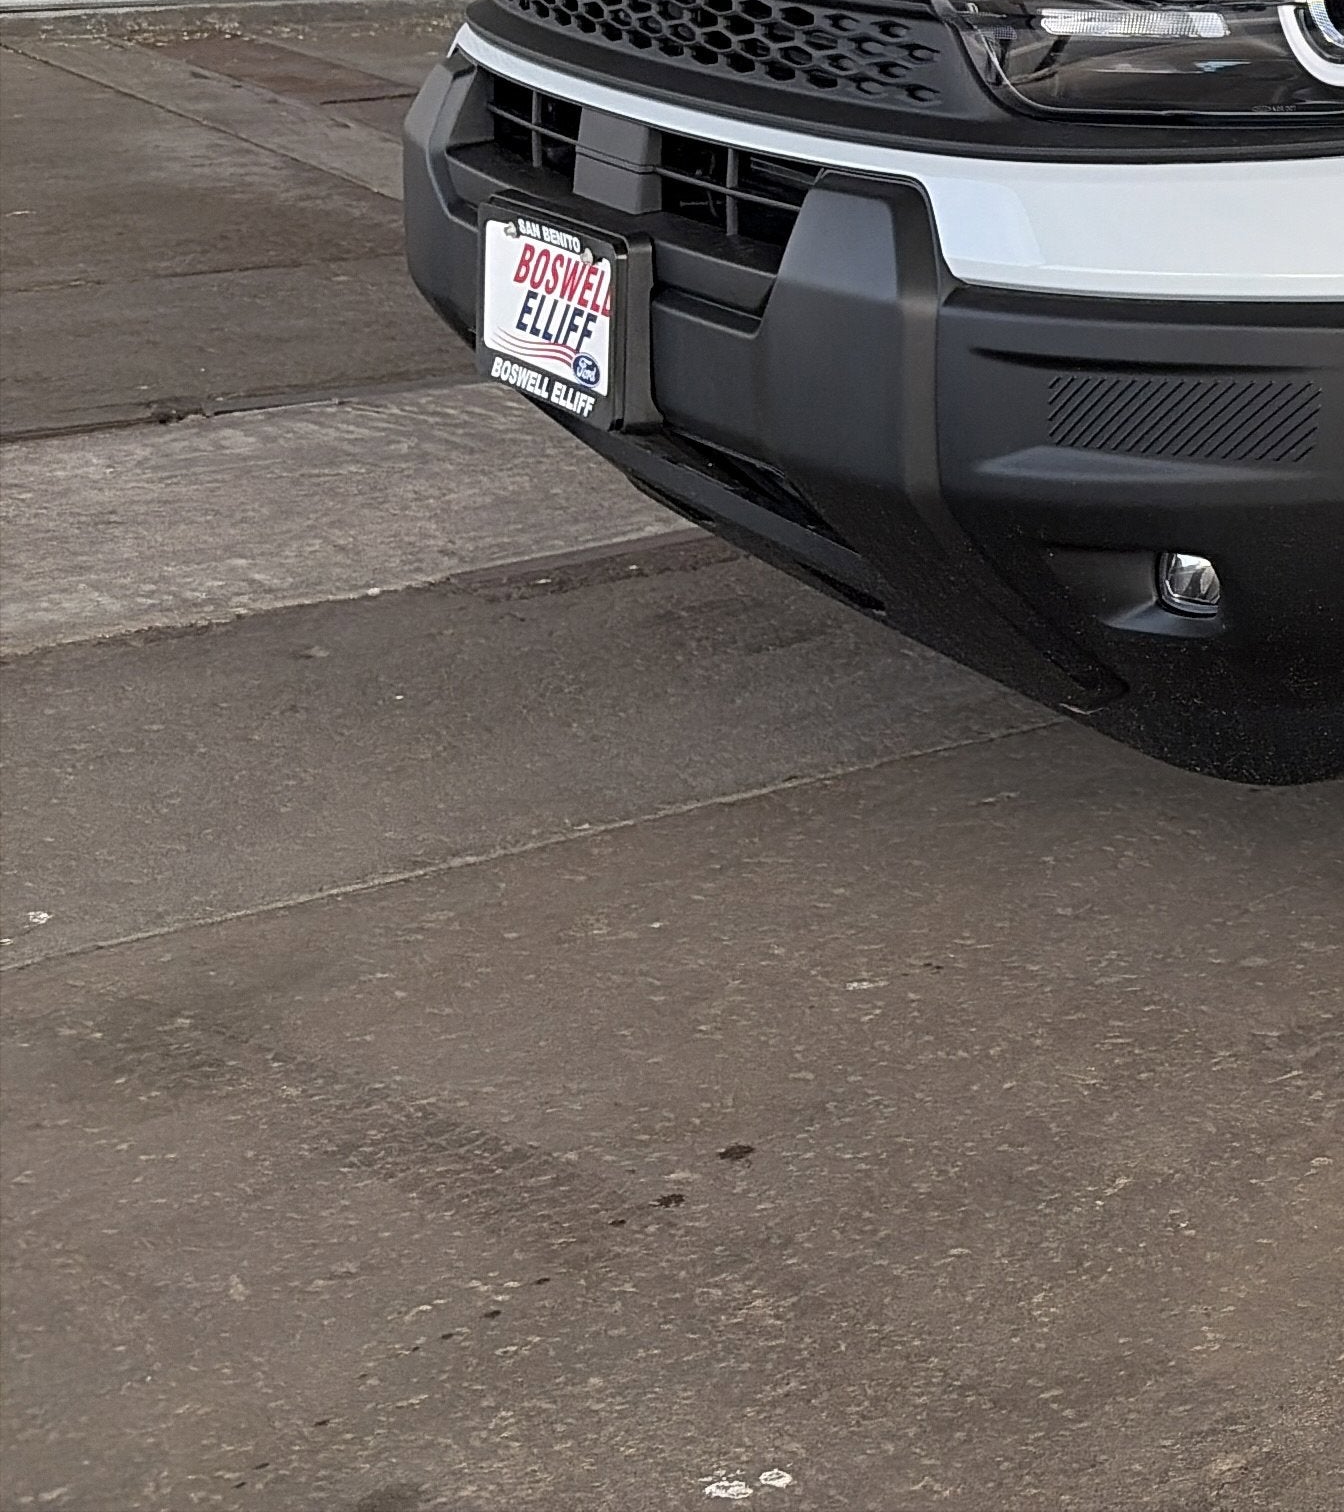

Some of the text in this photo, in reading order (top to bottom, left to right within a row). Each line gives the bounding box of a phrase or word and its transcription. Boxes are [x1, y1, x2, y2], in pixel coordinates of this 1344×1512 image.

[517, 218, 581, 253] SAN BENITO
[513, 243, 613, 318] BOSWELL
[515, 289, 598, 353] ELLIFF
[491, 356, 596, 418] BOSWELL ELLIFF
[576, 357, 597, 383] Ford
